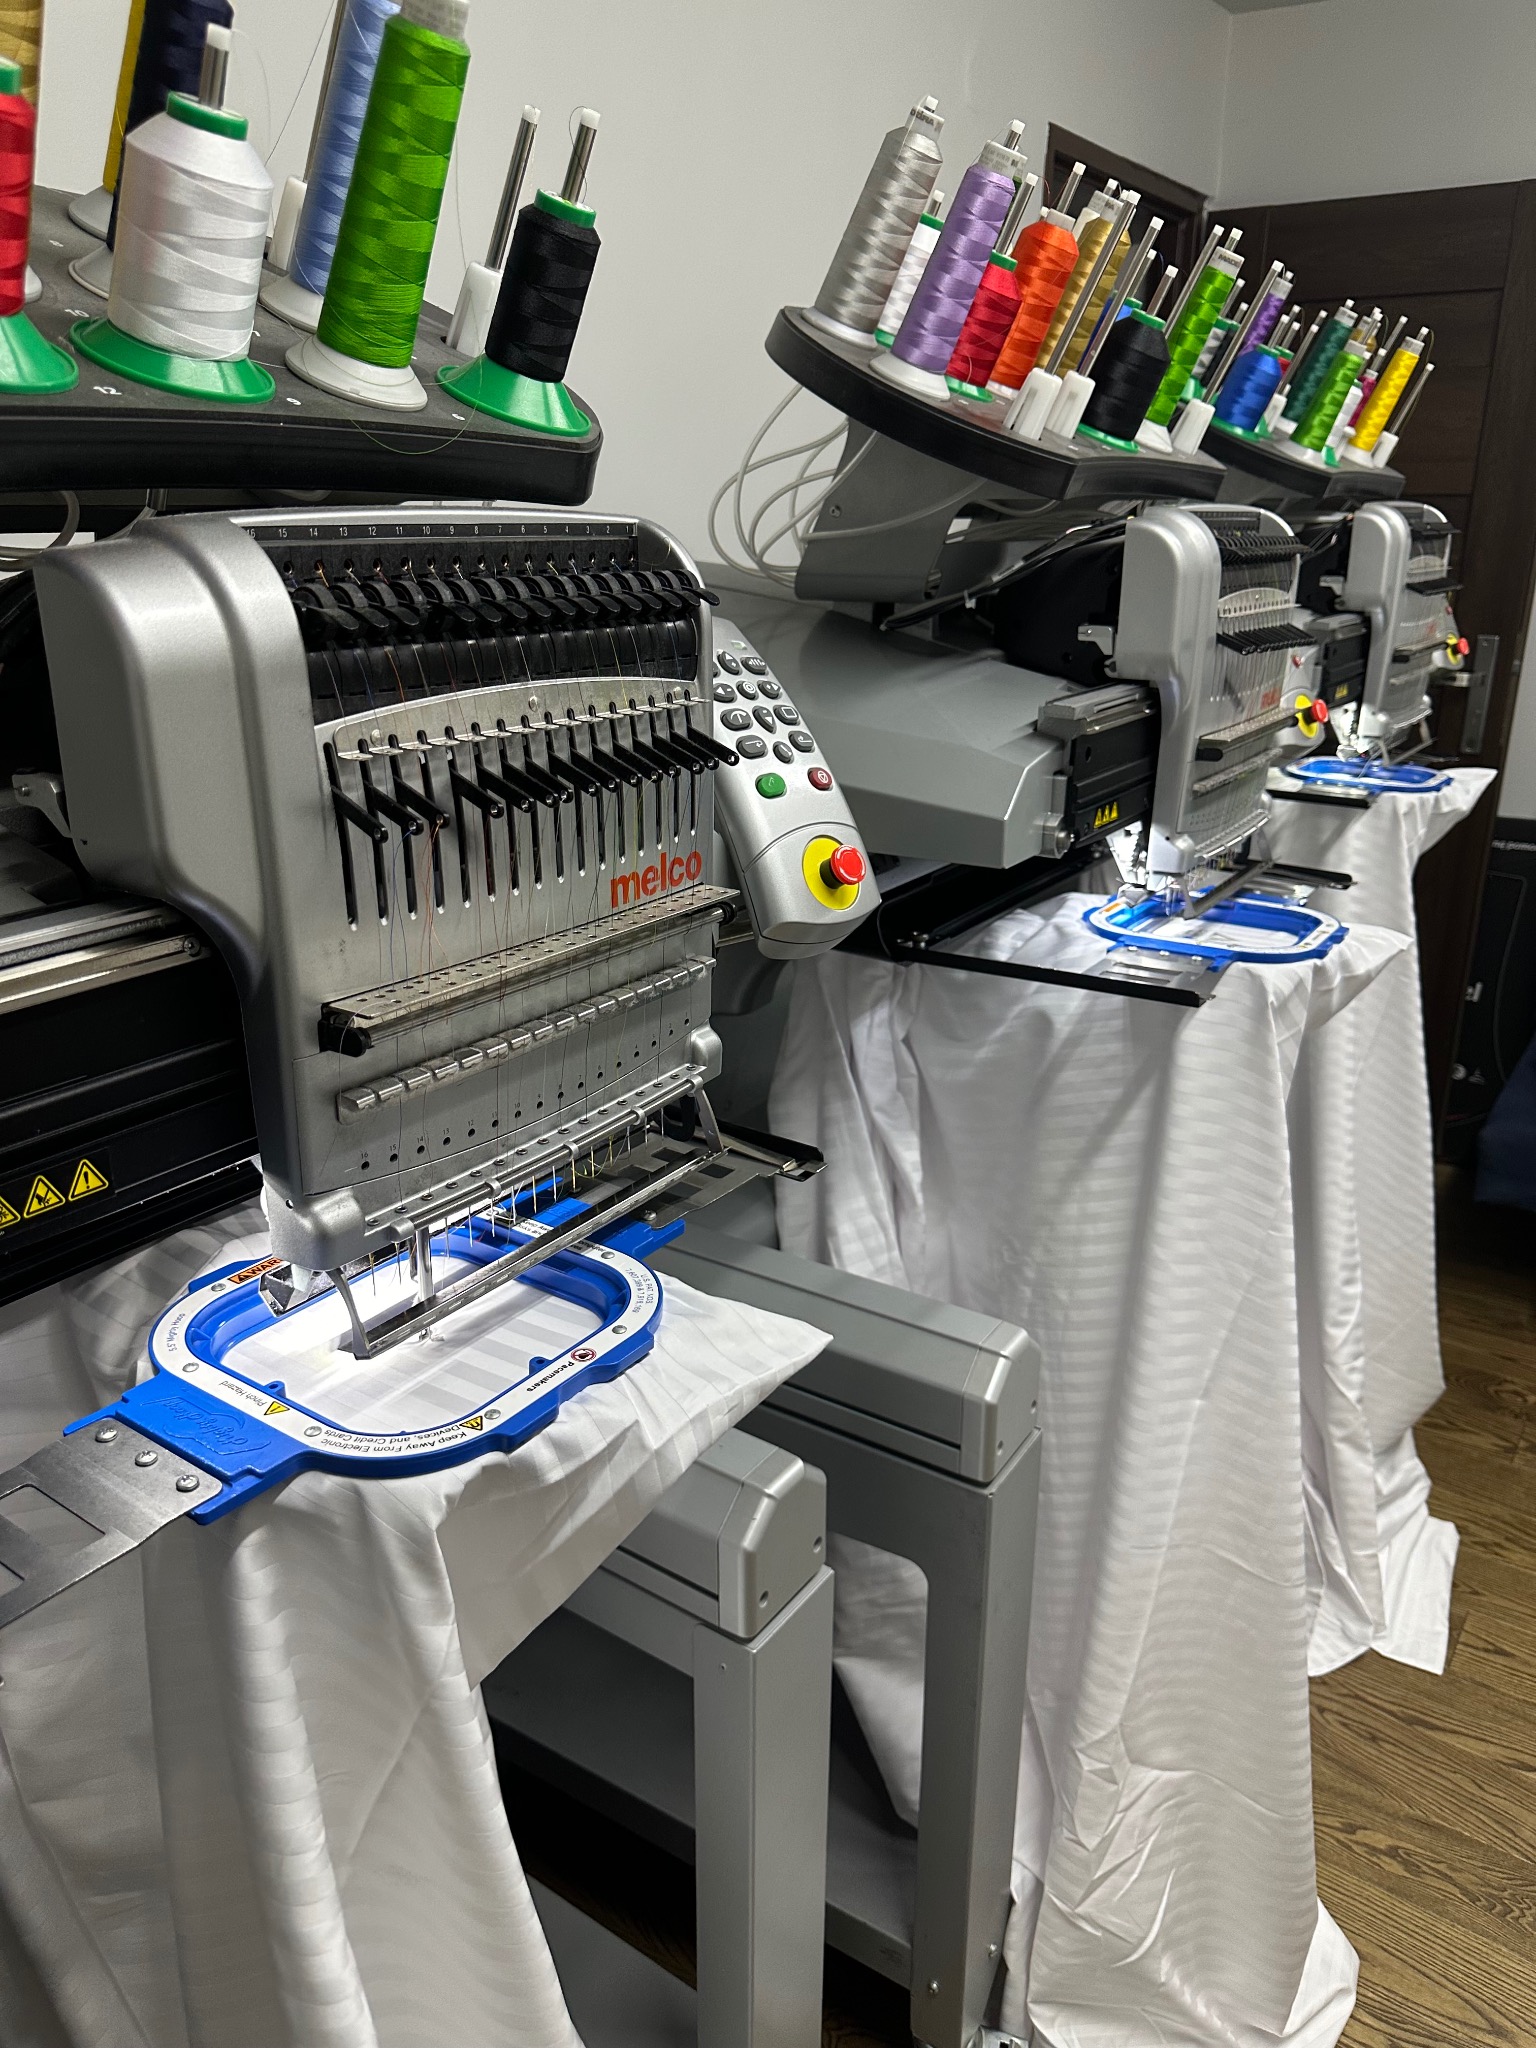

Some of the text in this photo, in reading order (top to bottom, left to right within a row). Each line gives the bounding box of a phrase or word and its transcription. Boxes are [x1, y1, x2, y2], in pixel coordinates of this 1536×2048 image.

[64, 308, 90, 318] 10
[93, 385, 123, 396] 12
[278, 528, 288, 538] 15
[309, 527, 319, 537] 14
[339, 527, 348, 536] 13
[368, 526, 377, 536] 12
[395, 526, 403, 535] 11
[422, 525, 431, 535] 10
[449, 525, 455, 535] 9
[474, 525, 479, 534] 8
[498, 525, 503, 534] 7
[521, 525, 526, 534] 6
[543, 525, 548, 534] 5
[564, 525, 569, 534] 4
[586, 525, 590, 534] 3
[606, 525, 610, 534] 2
[626, 525, 629, 533] 1
[610, 850, 703, 909] melco
[361, 1152, 369, 1160] 16
[389, 1143, 397, 1151] 15
[416, 1135, 424, 1143] 14
[442, 1127, 450, 1135] 13
[467, 1119, 475, 1127] 12
[526, 1360, 575, 1392] Pacemakers
[218, 1380, 268, 1407] Pinch Hazard
[320, 1431, 467, 1453] Keep Away From Electronic
[324, 1424, 462, 1445] Devices, and Credit Cards
